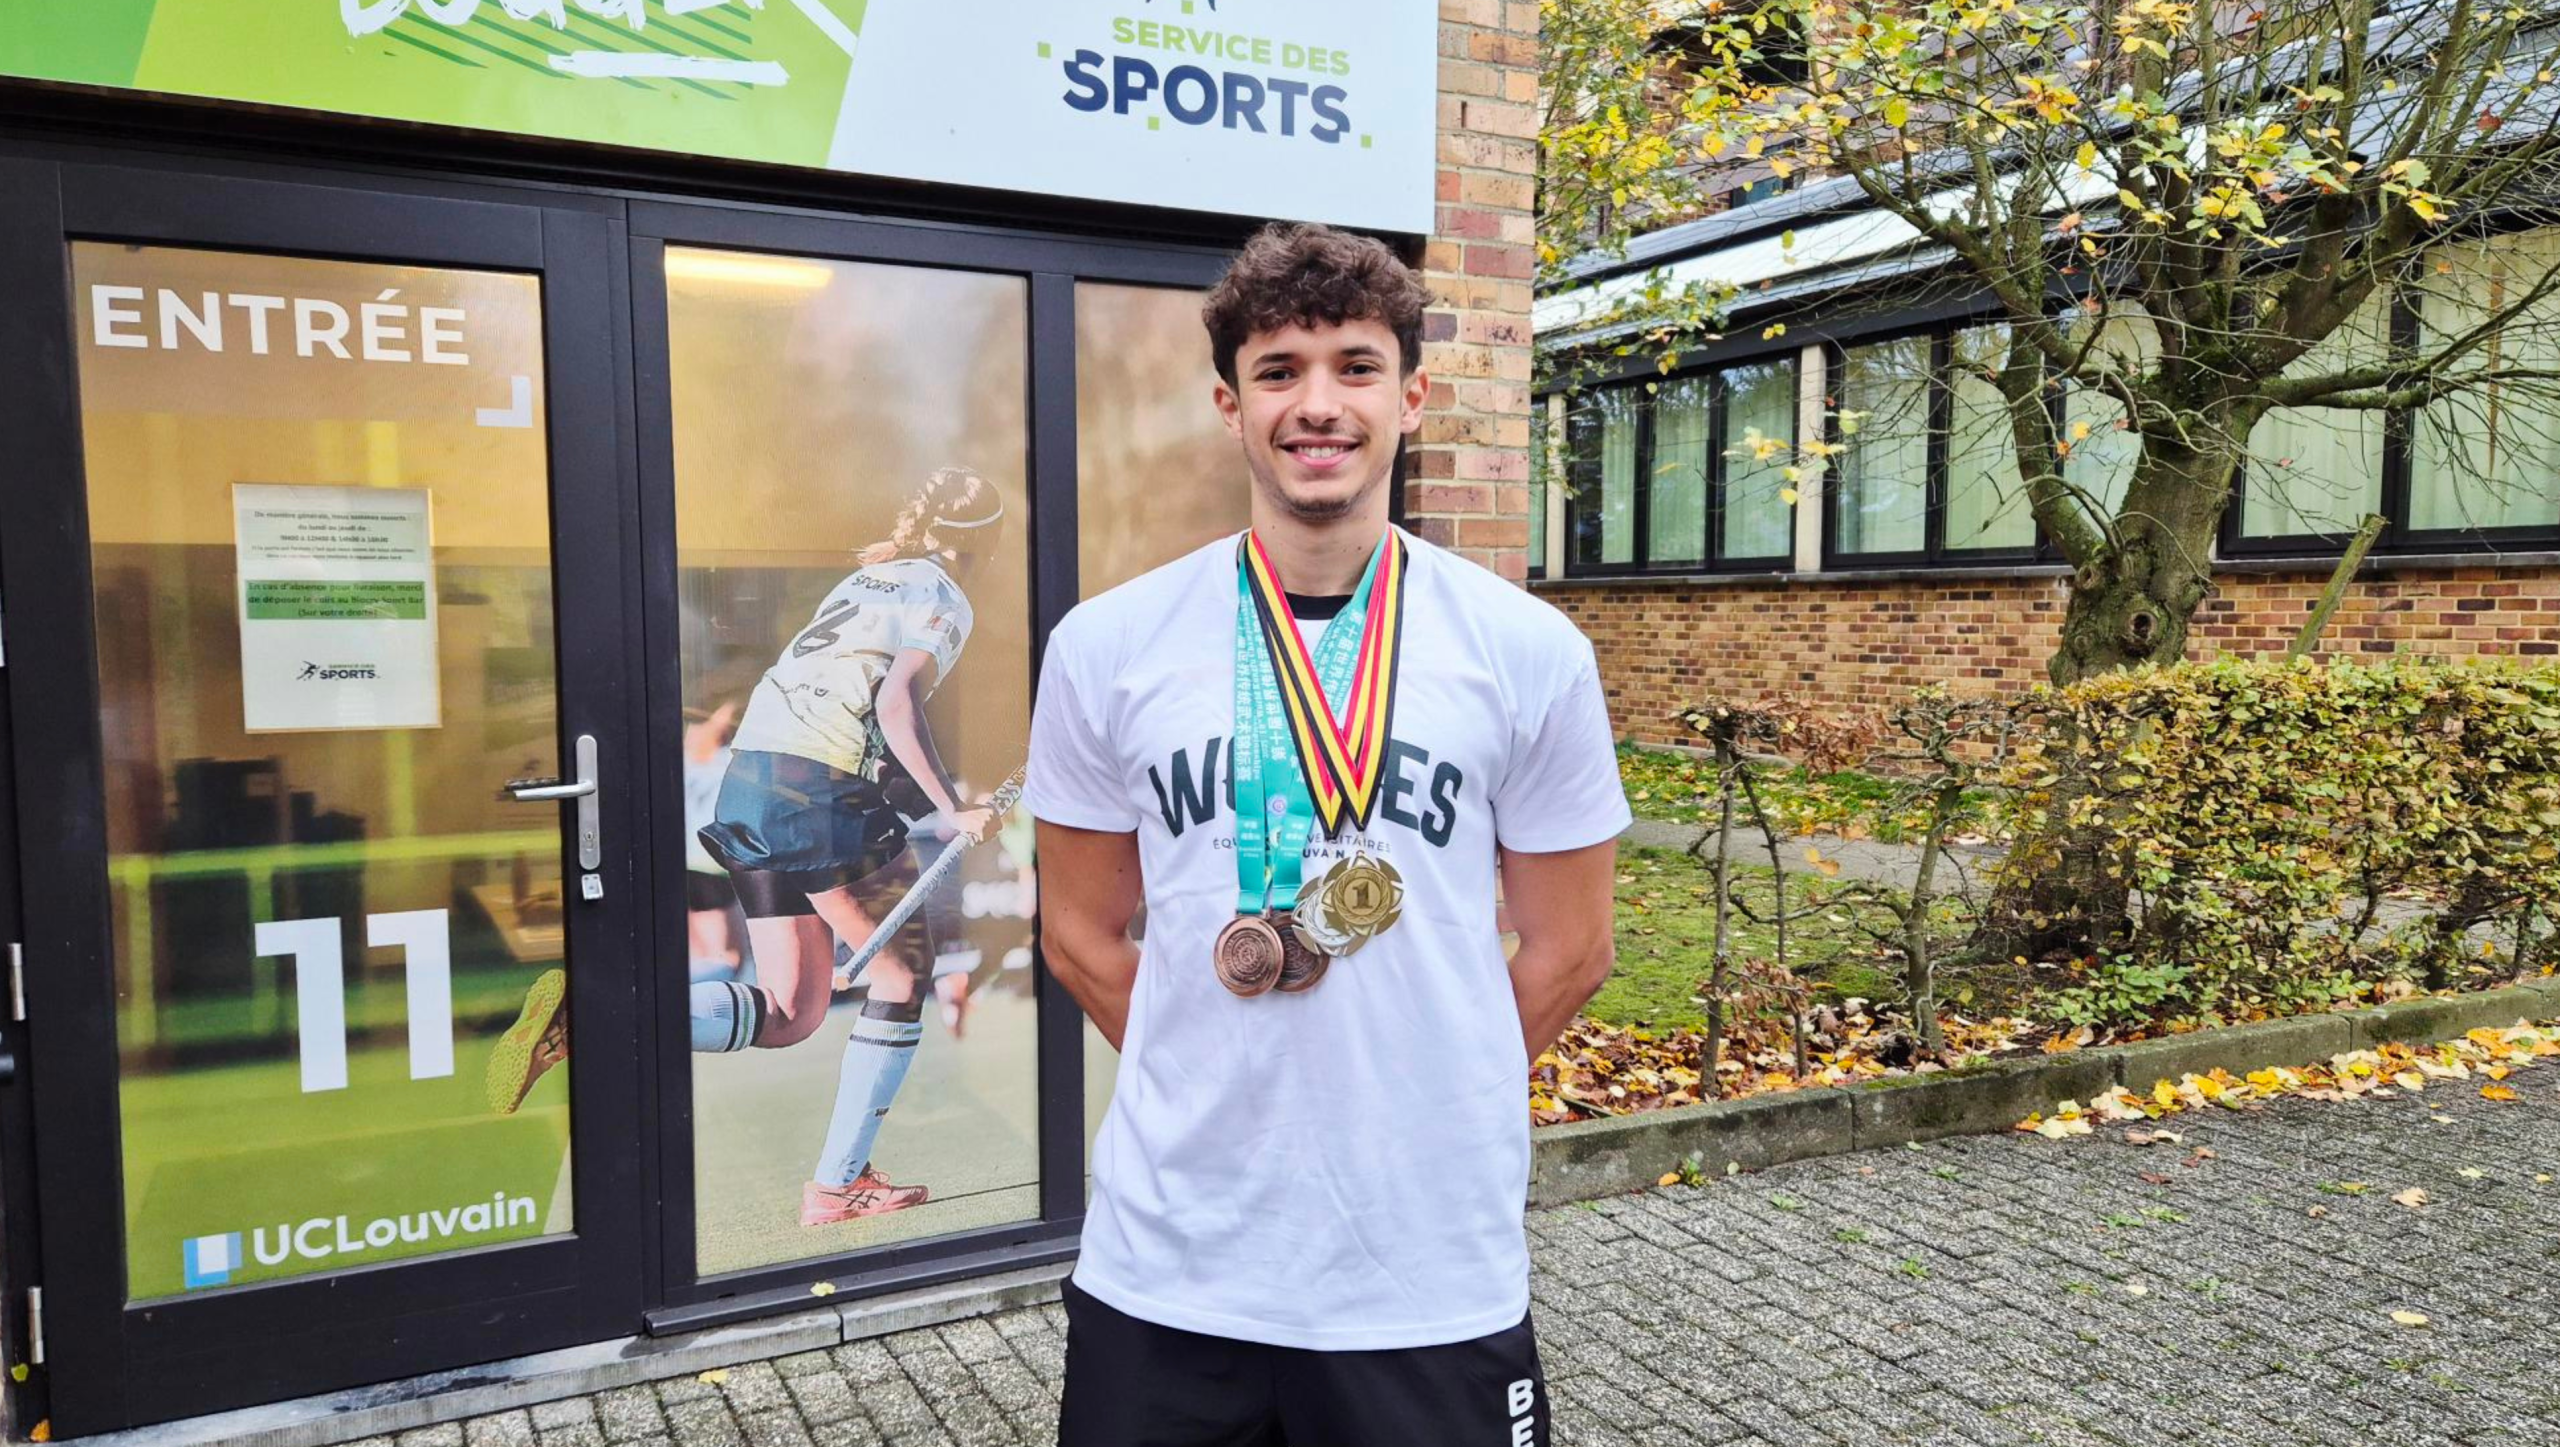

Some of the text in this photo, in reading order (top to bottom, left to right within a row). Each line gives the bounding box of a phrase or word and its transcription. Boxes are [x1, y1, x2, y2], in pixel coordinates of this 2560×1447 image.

[1112, 16, 1351, 77] SERVICE DES
[1062, 49, 1351, 145] SPORTS
[91, 283, 470, 366] ENTRÉE
[319, 669, 376, 680] SPORTS
[1148, 736, 1463, 848] WES
[1352, 881, 1373, 909] 1
[254, 908, 454, 1093] 11
[253, 1191, 537, 1267] UCLouvain
